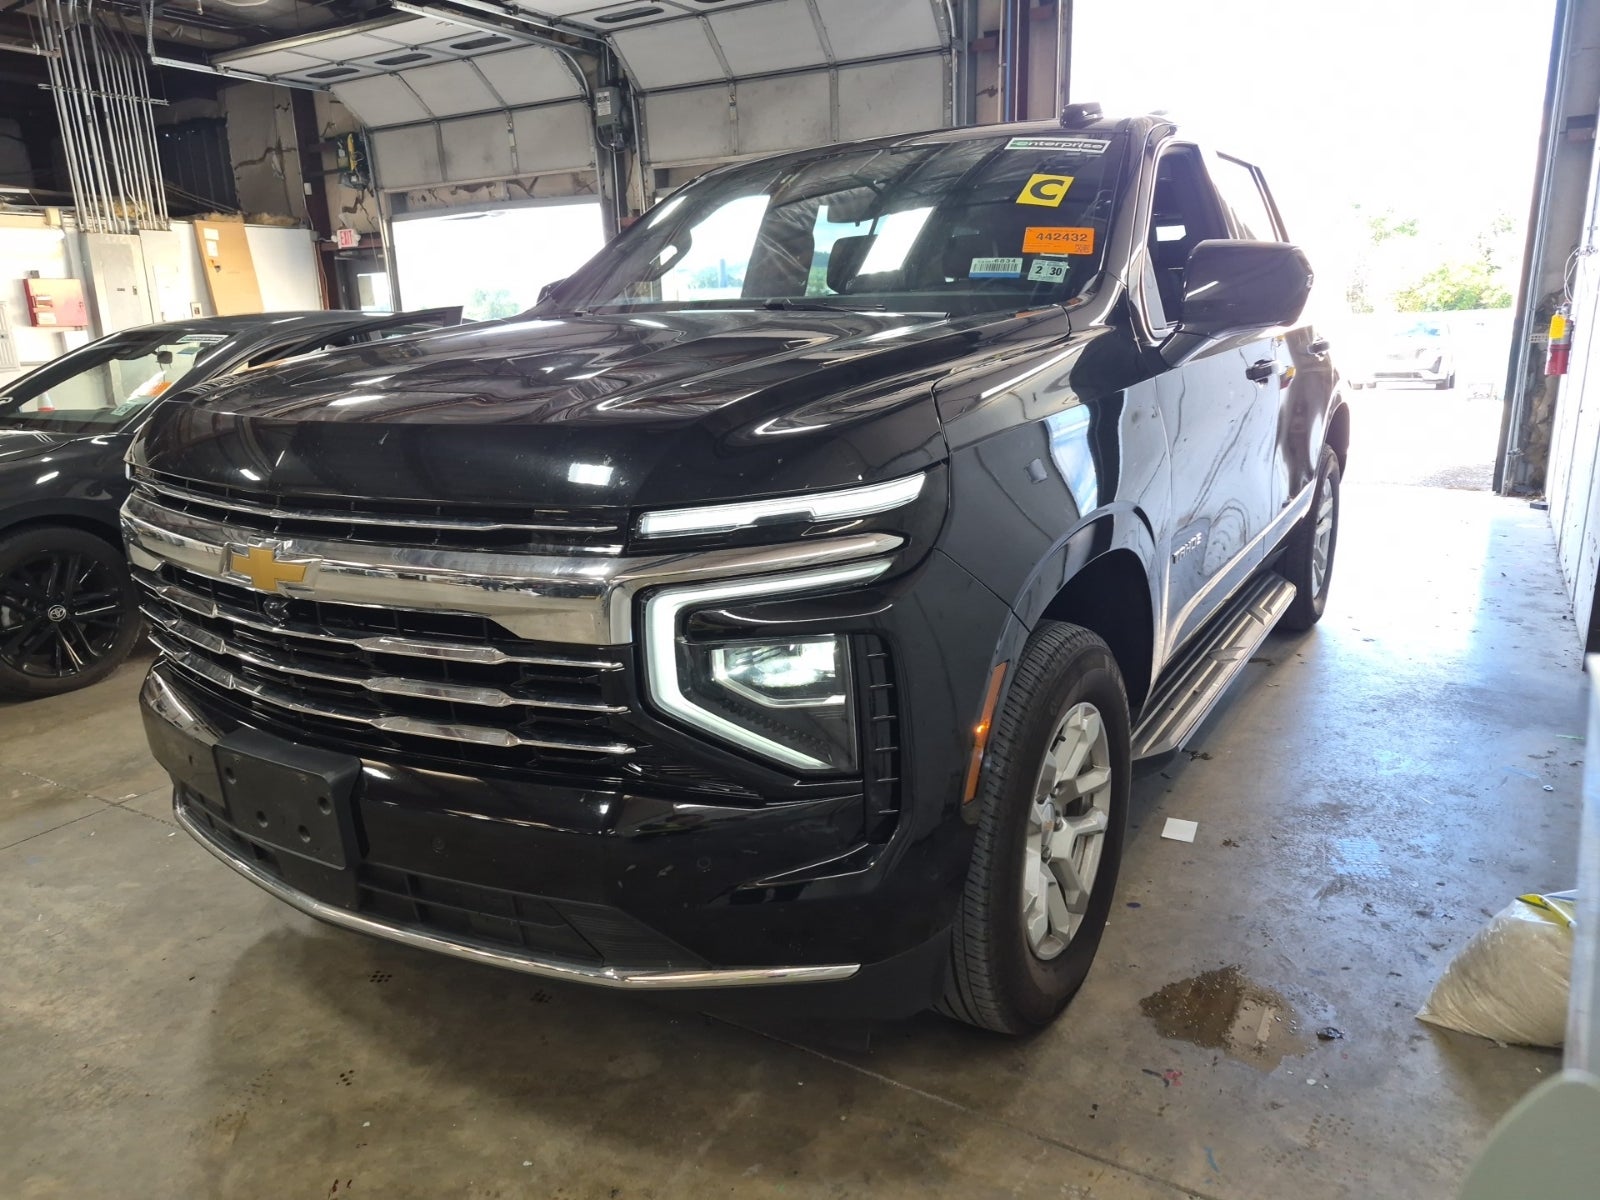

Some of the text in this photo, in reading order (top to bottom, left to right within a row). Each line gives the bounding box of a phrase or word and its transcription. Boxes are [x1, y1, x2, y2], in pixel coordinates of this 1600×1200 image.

[1012, 140, 1104, 150] enterprise
[1029, 179, 1065, 200] C
[1036, 233, 1088, 241] 442432
[1035, 266, 1062, 276] 2 30
